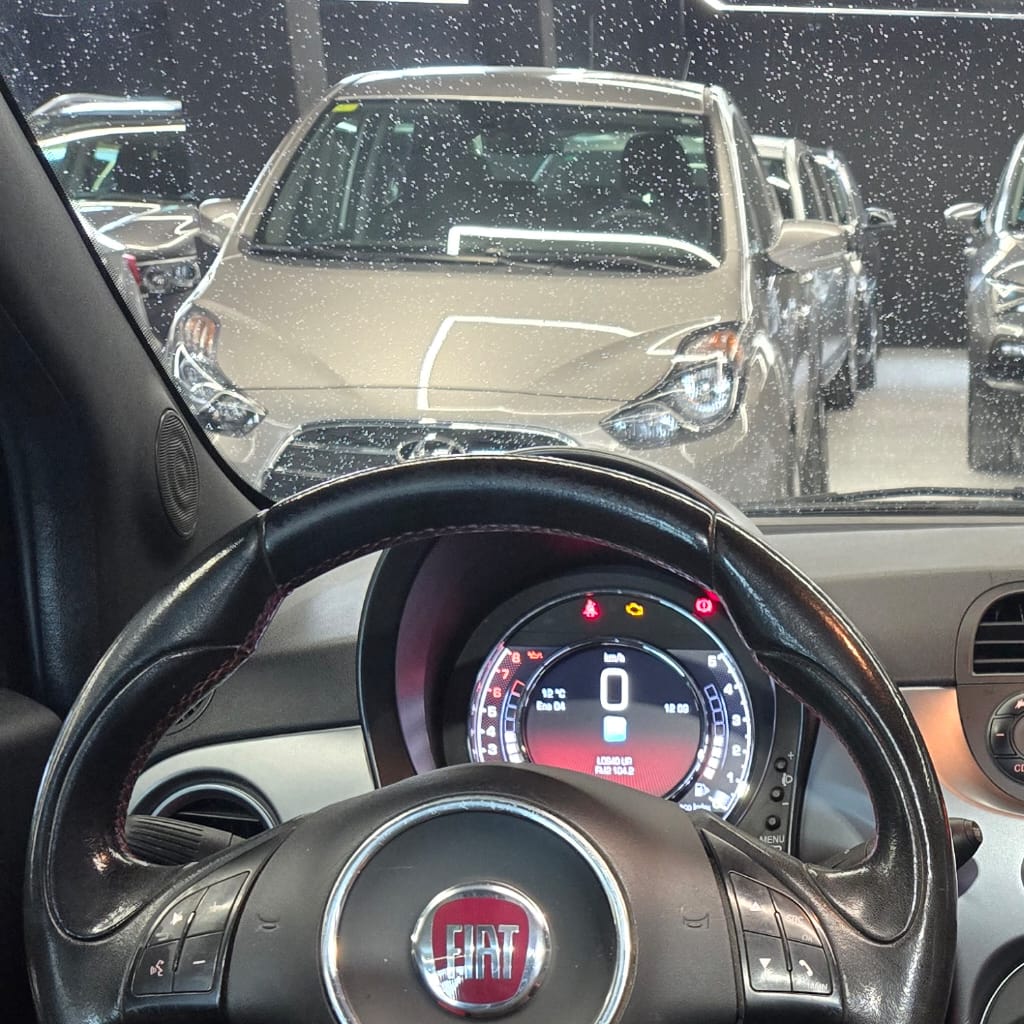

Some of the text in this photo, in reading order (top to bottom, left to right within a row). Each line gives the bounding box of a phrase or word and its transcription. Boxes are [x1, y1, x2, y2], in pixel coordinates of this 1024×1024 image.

[512, 652, 520, 663] 8
[501, 669, 509, 679] 7
[493, 687, 501, 698] 6
[600, 668, 628, 711] 0
[723, 683, 733, 695] 4
[486, 726, 496, 737] 4
[732, 745, 741, 756] 2
[446, 924, 520, 979] FIAT
